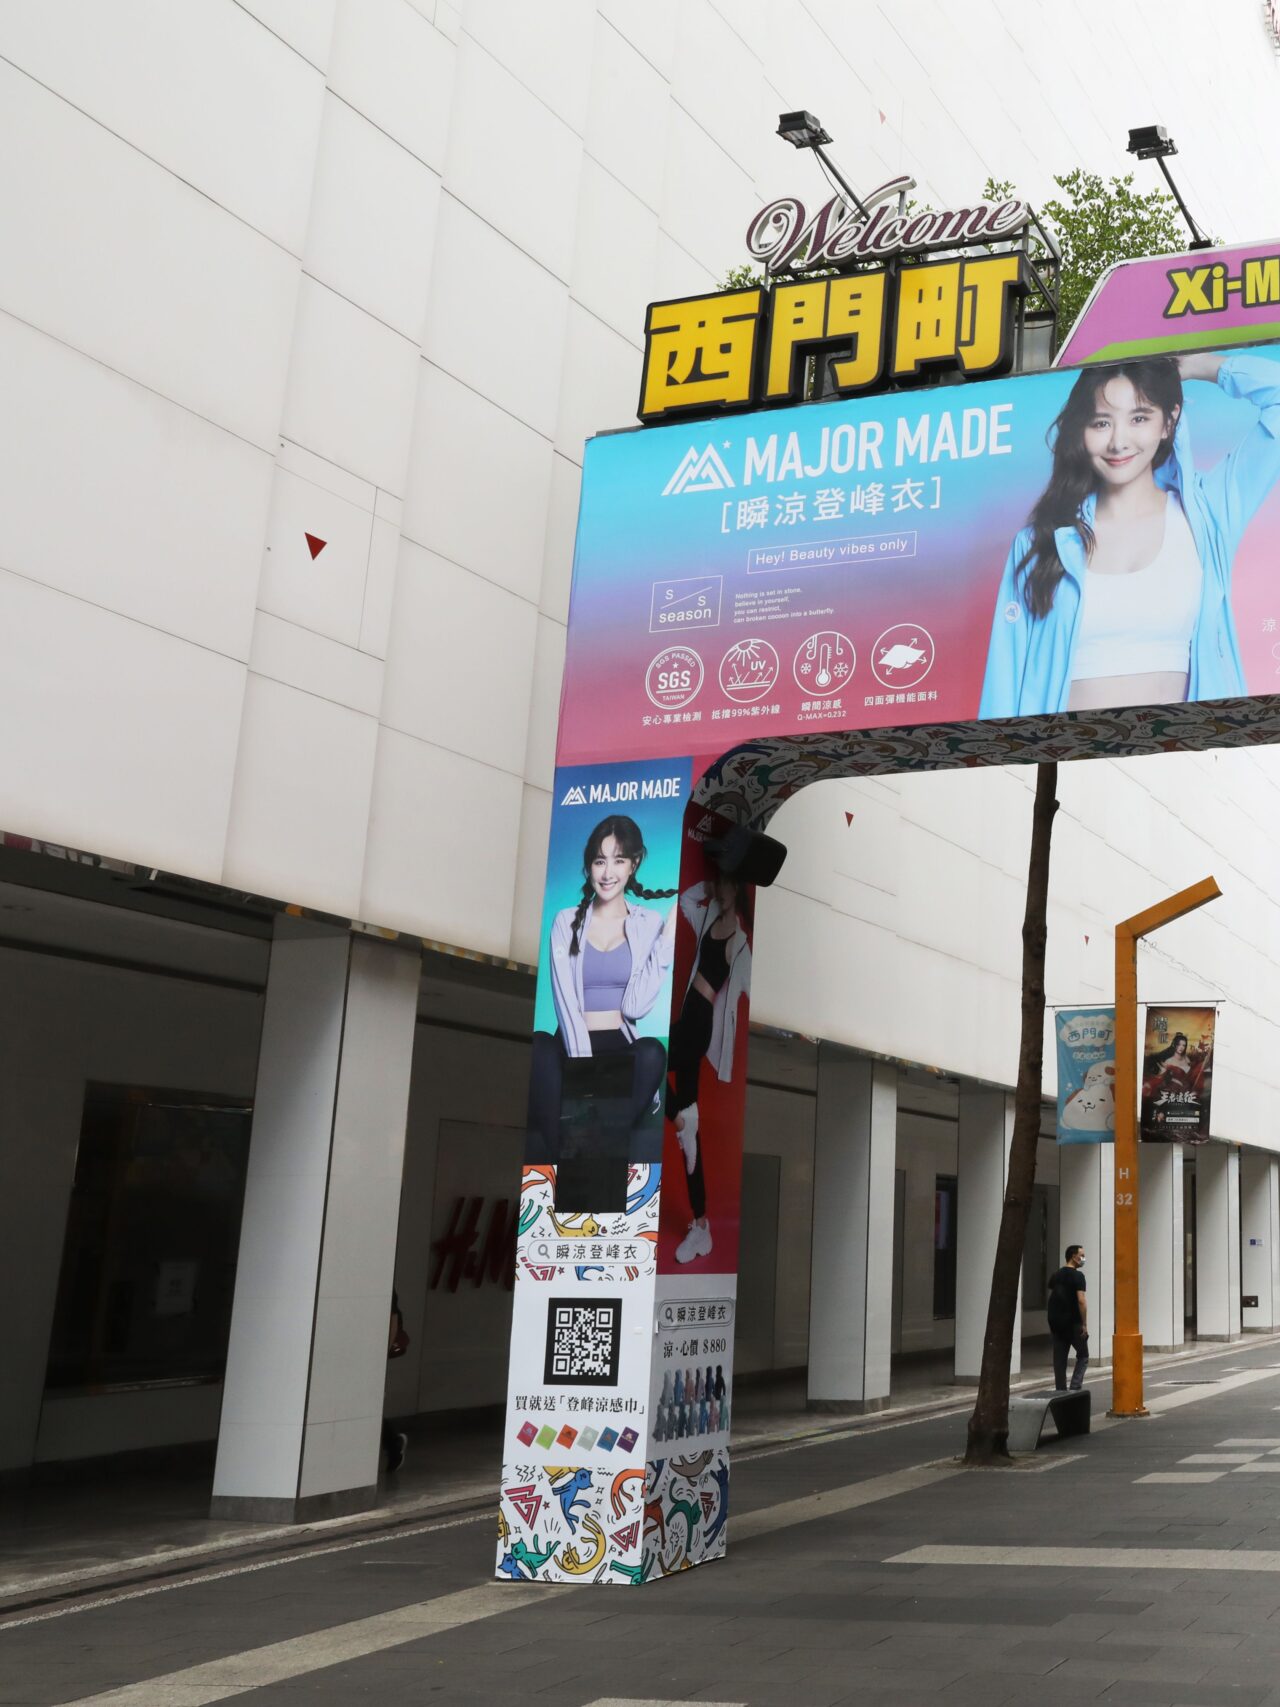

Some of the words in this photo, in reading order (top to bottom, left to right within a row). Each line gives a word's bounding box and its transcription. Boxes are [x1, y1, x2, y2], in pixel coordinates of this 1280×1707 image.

[746, 175, 1028, 272] Welcome
[639, 251, 1026, 424] 西門町
[743, 420, 884, 486] MAJOR
[895, 403, 1013, 467] MADE
[755, 551, 785, 568] Hey!
[789, 545, 835, 562] Beauty
[838, 541, 875, 556] vibes
[879, 537, 908, 553] only
[665, 589, 674, 600] S
[697, 595, 706, 606] S
[658, 607, 712, 624] season
[671, 653, 696, 668] PASSED
[751, 660, 766, 671] UV
[658, 670, 691, 689] SGS
[662, 693, 685, 701] TAIWAN
[863, 691, 938, 707] 四面彈機能面料
[589, 780, 638, 804] MAJOR
[641, 777, 681, 800] MADE
[1067, 1027, 1112, 1043] 西門町
[1119, 1168, 1129, 1179] H
[1116, 1193, 1133, 1206] 32
[555, 1243, 638, 1260] 瞬涼登峰衣
[677, 1305, 727, 1322] 瞬涼登峰衣
[703, 1338, 727, 1354] $880
[515, 1394, 646, 1415] 買就送「登峰涼感巾」
